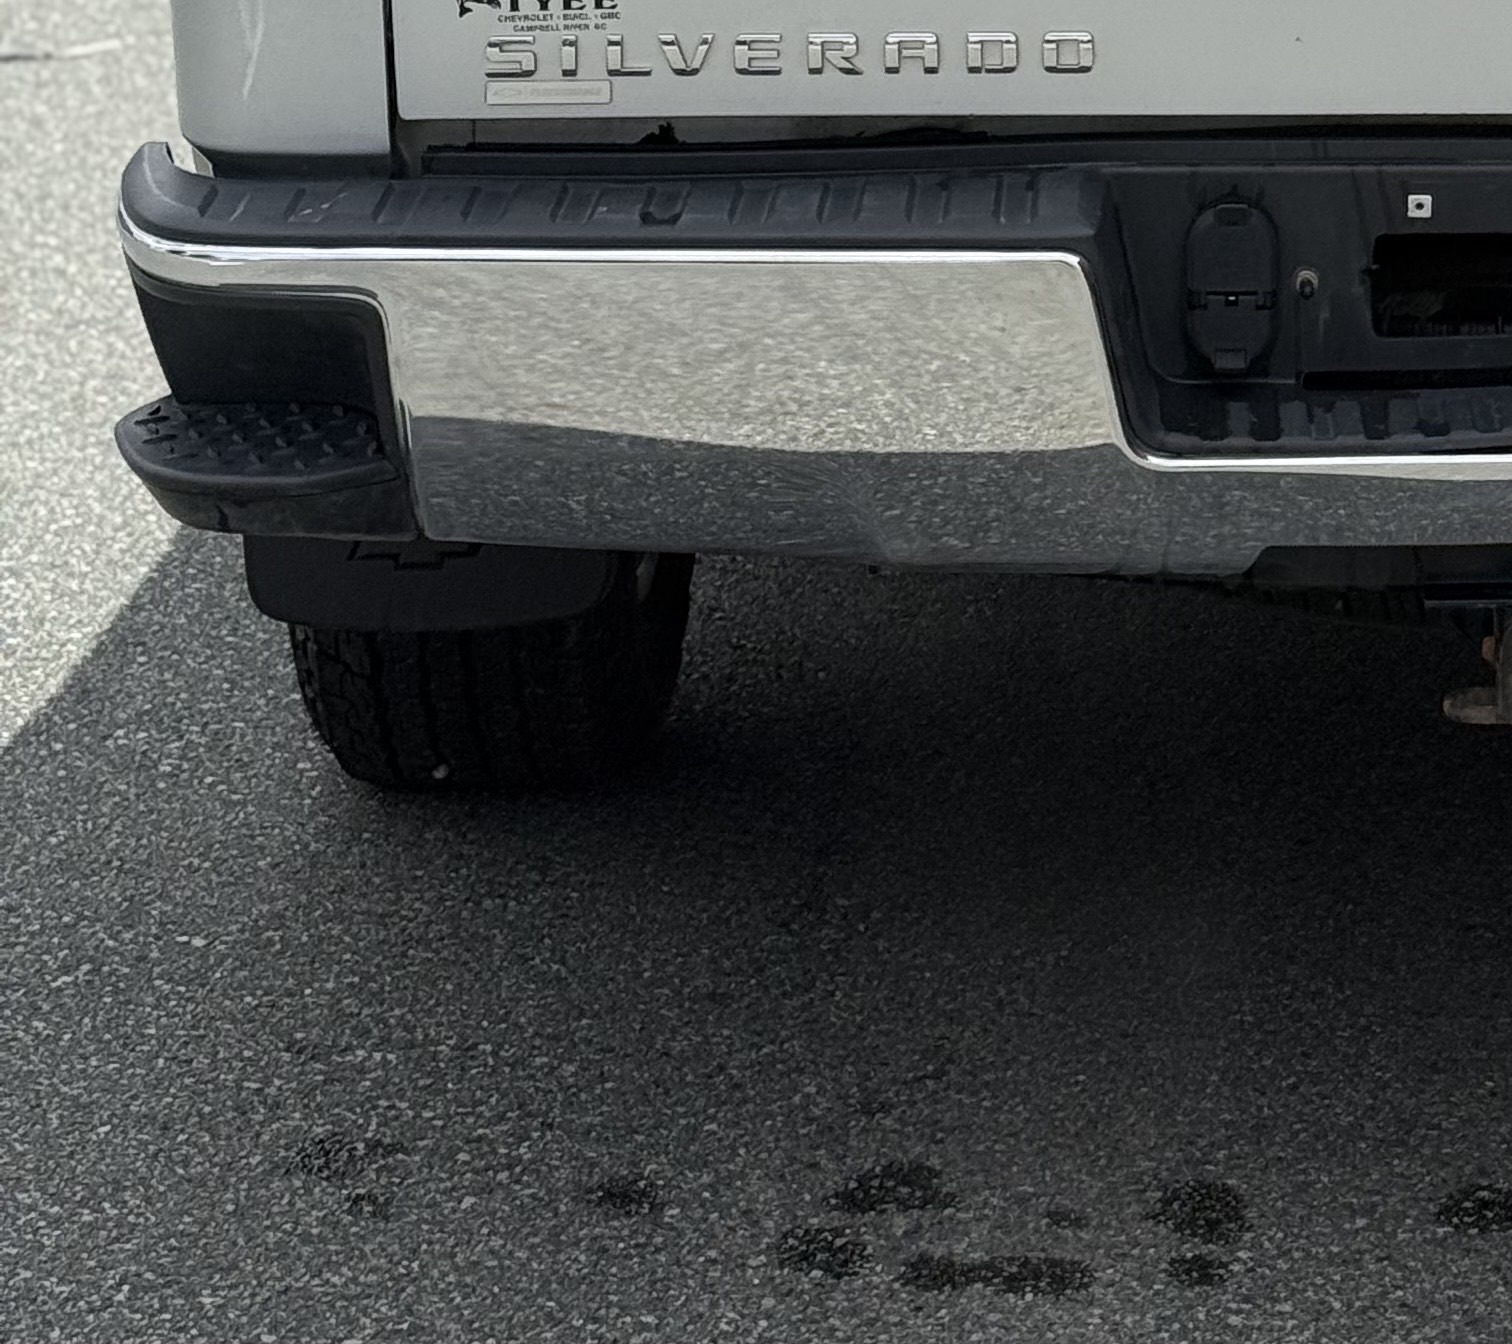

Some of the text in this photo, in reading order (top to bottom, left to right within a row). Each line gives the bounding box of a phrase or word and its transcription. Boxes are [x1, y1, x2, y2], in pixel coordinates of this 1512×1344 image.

[497, 13, 554, 23] CHEVROLET
[513, 24, 561, 32] CAMPBELL
[484, 32, 1095, 77] SILVERADO
